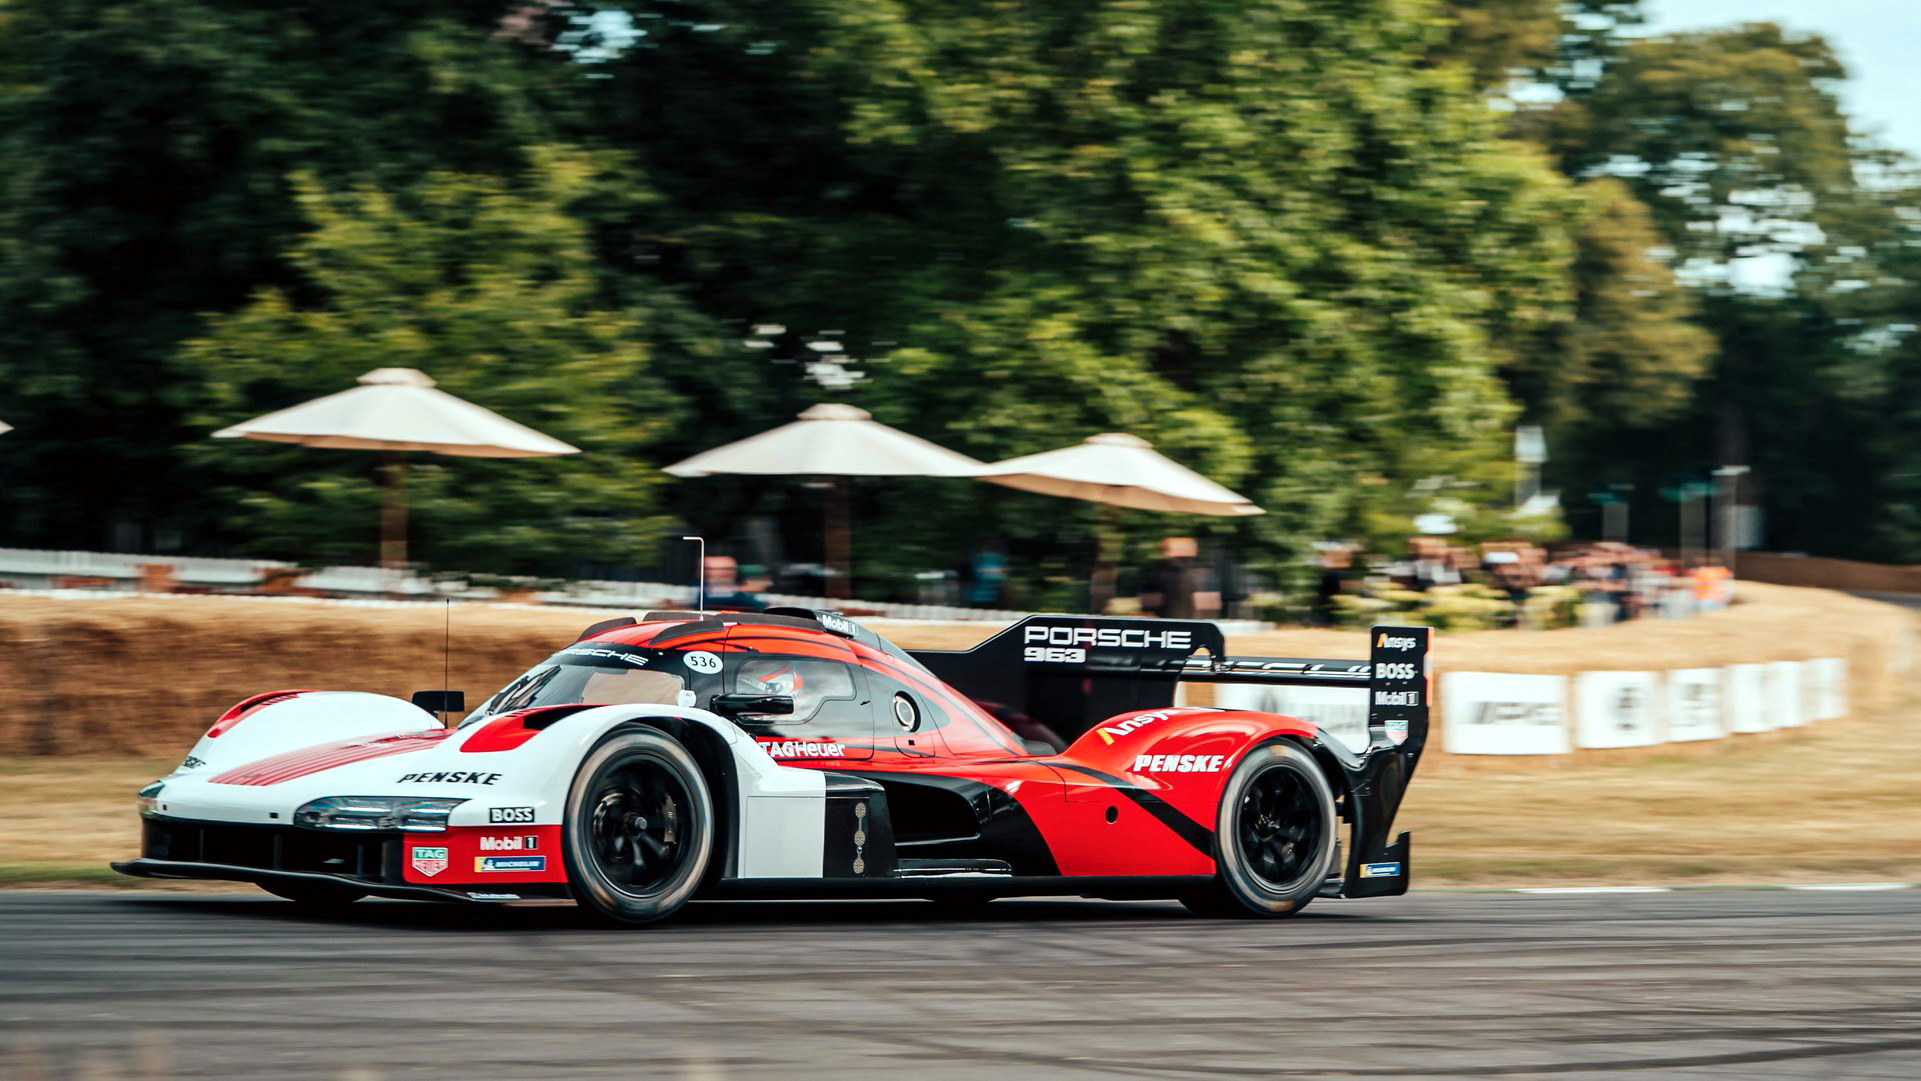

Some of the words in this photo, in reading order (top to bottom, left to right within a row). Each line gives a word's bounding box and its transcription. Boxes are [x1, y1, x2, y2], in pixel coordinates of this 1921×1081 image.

[822, 614, 849, 632] Mobil
[1024, 625, 1192, 649] PORSCHE
[1377, 633, 1416, 652] Ansys
[690, 656, 717, 668] 536
[1024, 646, 1086, 663] 963
[1375, 662, 1415, 680] BOSS
[1375, 691, 1407, 706] Mobil
[1096, 709, 1181, 746] Ansys
[1133, 754, 1225, 773] PENSKE
[396, 771, 502, 786] PENSKE
[492, 808, 533, 822] BOSS
[480, 836, 523, 851] Mobil
[415, 849, 446, 859] TAG
